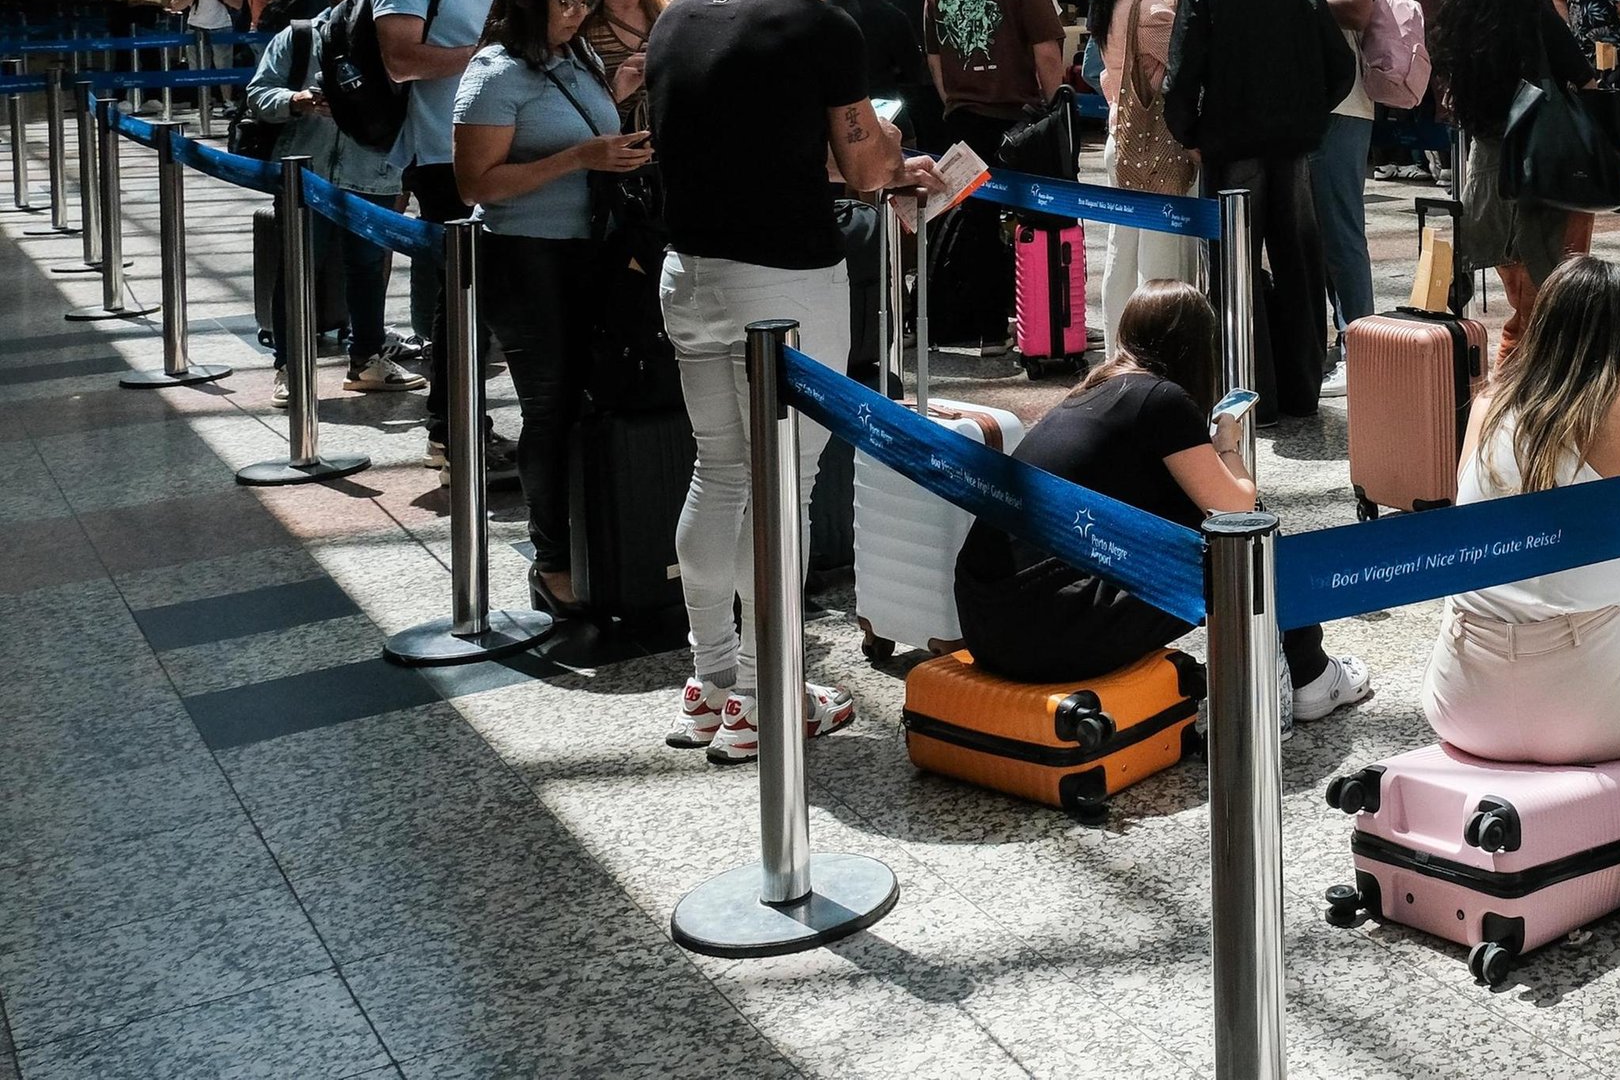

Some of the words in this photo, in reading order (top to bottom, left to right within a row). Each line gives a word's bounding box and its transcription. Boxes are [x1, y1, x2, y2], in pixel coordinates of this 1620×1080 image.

[1092, 534, 1108, 550] Porto
[1108, 541, 1128, 560] Alegre
[1331, 572, 1359, 588] Boa
[1364, 560, 1422, 584] Viagem!
[1426, 553, 1455, 571] Nice
[1459, 546, 1488, 567] Trip!
[1492, 538, 1522, 558] Gute
[1526, 529, 1562, 548] Reise!
